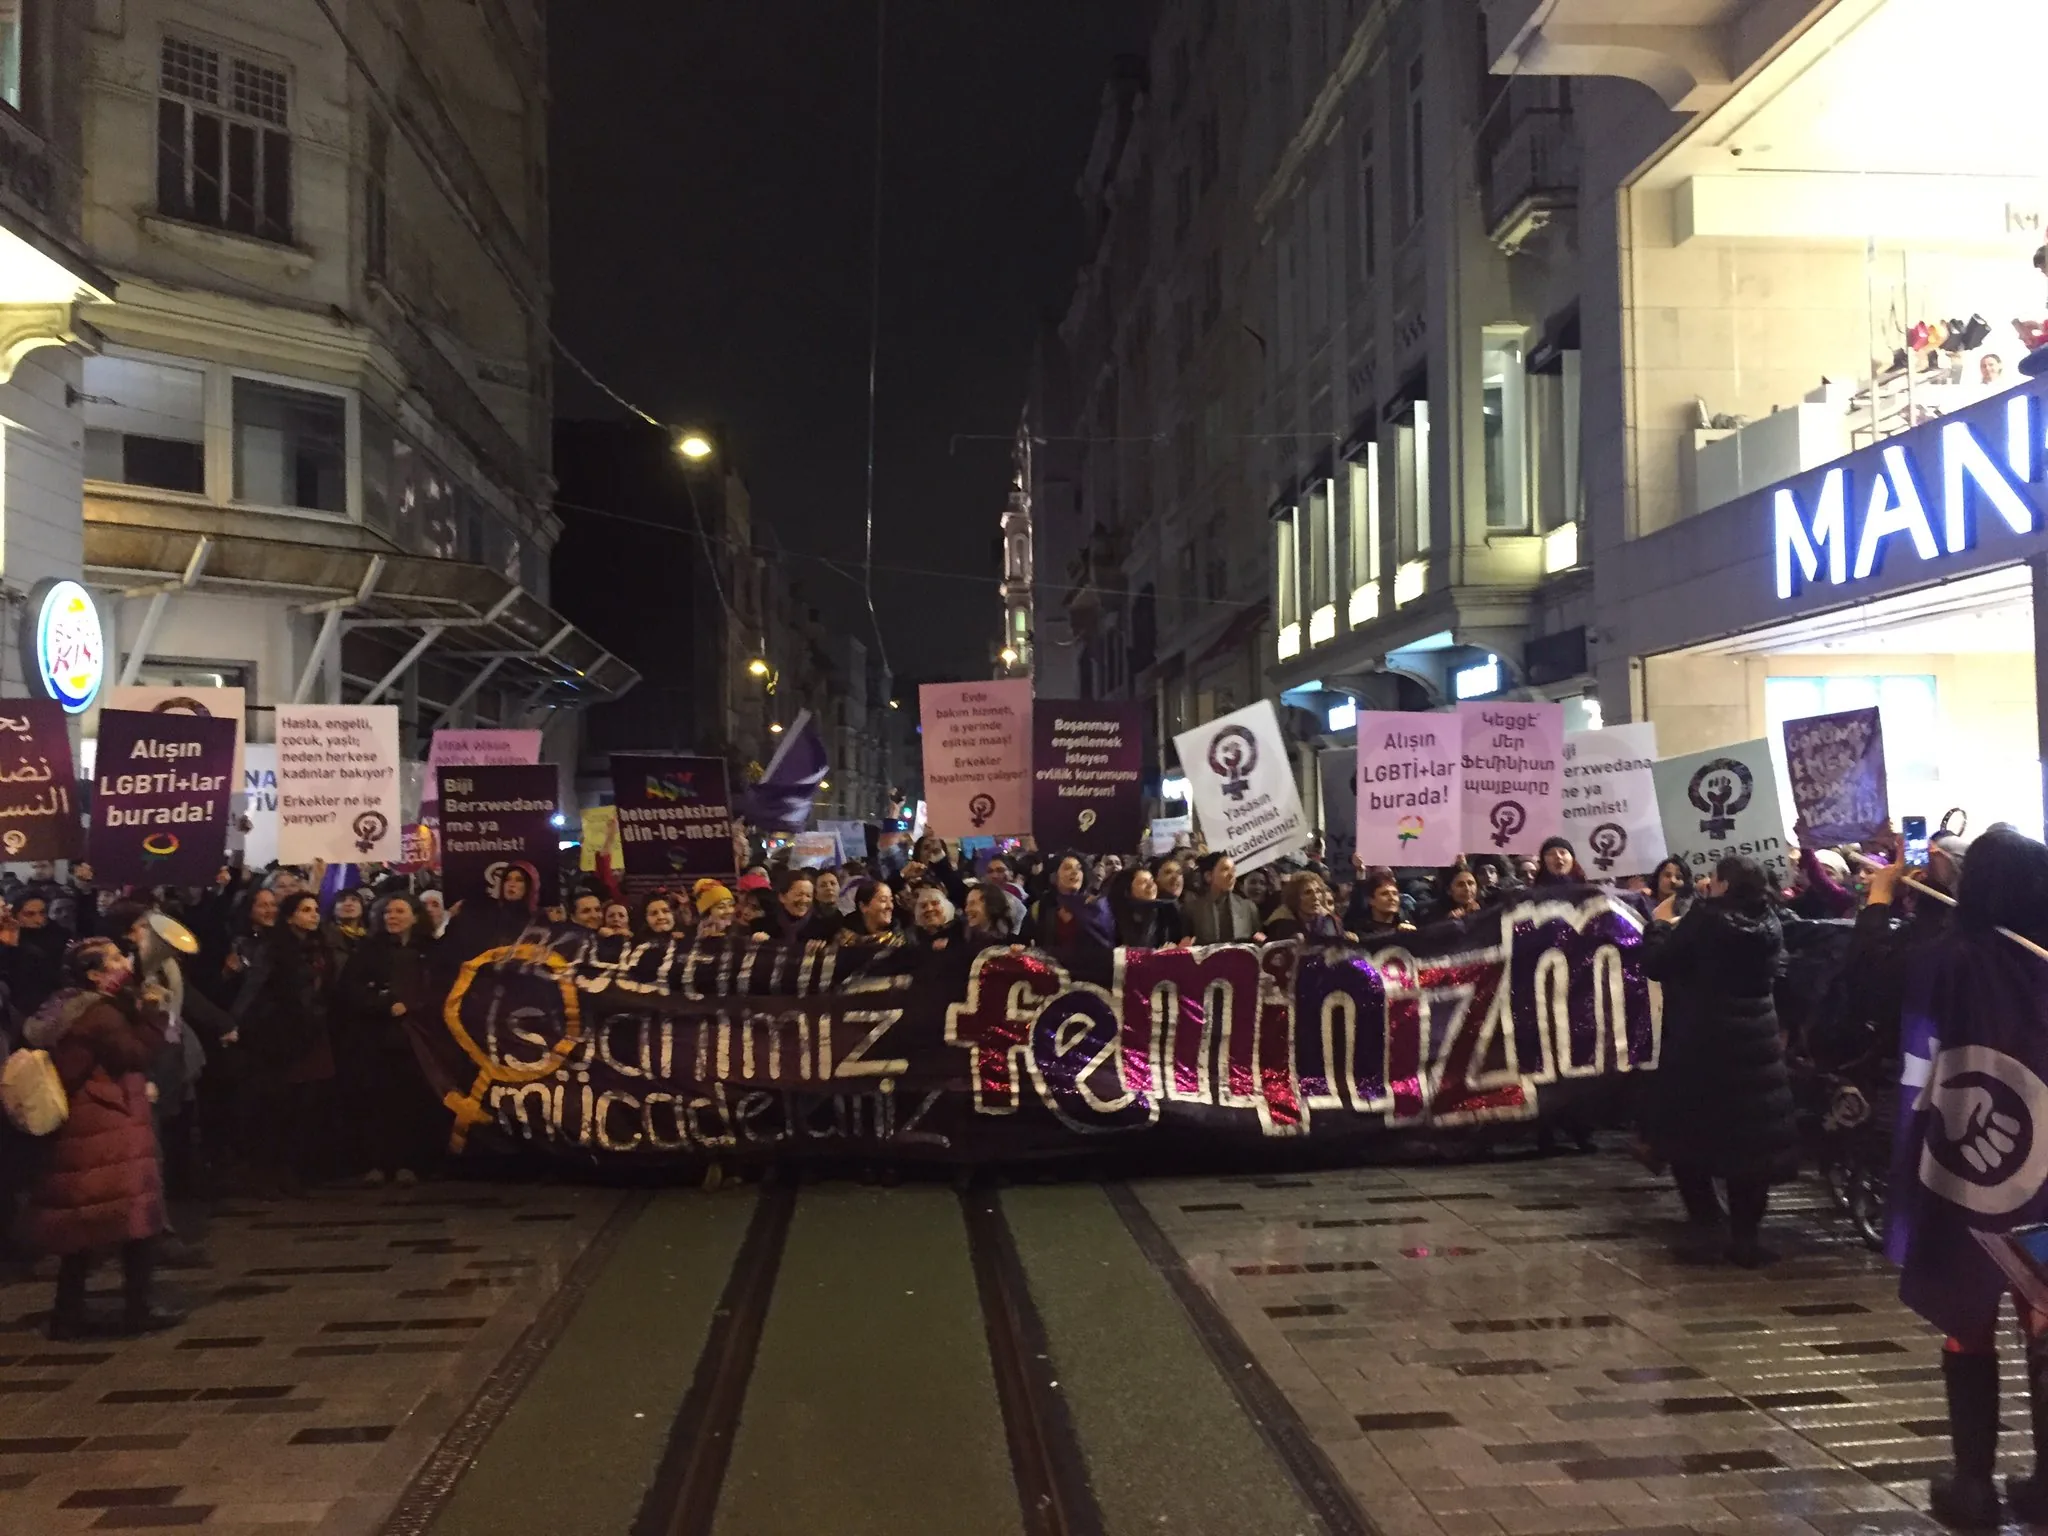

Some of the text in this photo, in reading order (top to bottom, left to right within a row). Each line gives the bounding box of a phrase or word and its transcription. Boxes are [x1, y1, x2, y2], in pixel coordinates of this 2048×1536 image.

[1774, 394, 2048, 600] MAN
[130, 739, 202, 762] Alışın
[1384, 731, 1435, 752] Alışın
[282, 752, 377, 762] neden herkese
[1563, 757, 1652, 778] erxwedana
[282, 766, 394, 780] kadınlar bakıyor?
[1364, 757, 1456, 783] LGBTİ+lar
[100, 768, 226, 796] LGBTİ+lar
[1583, 784, 1602, 799] ya
[283, 795, 340, 807] Erkekler
[343, 796, 360, 806] ne
[1370, 784, 1448, 810] burada!
[106, 800, 214, 827] burada!
[1562, 799, 1629, 819] eminist!
[446, 821, 474, 832] me
[478, 820, 500, 835] ya
[1226, 806, 1280, 840] Feminist
[446, 836, 525, 852] feminist!
[945, 895, 1664, 1137] feminizm
